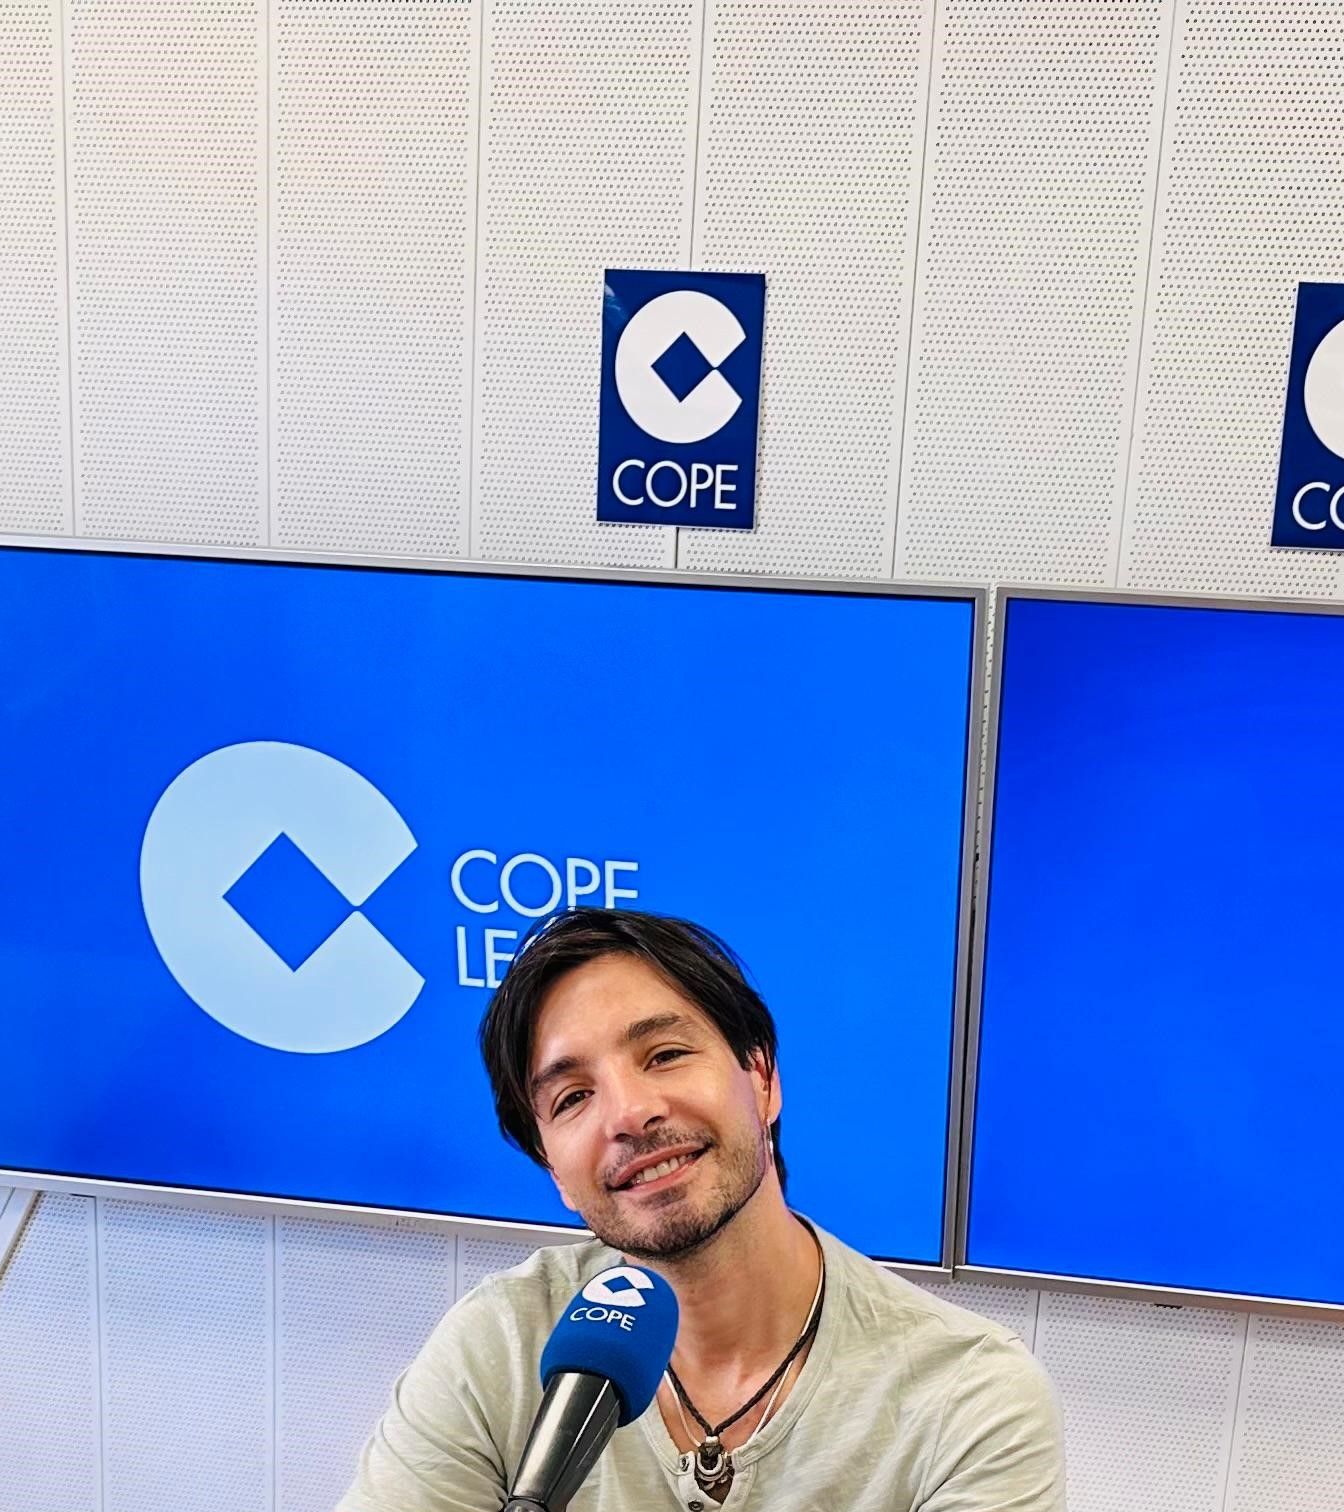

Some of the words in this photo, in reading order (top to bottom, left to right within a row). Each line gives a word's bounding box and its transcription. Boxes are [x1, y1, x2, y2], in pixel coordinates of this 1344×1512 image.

[612, 458, 739, 510] COPE
[450, 849, 641, 918] COPE
[569, 1307, 637, 1332] COPE
